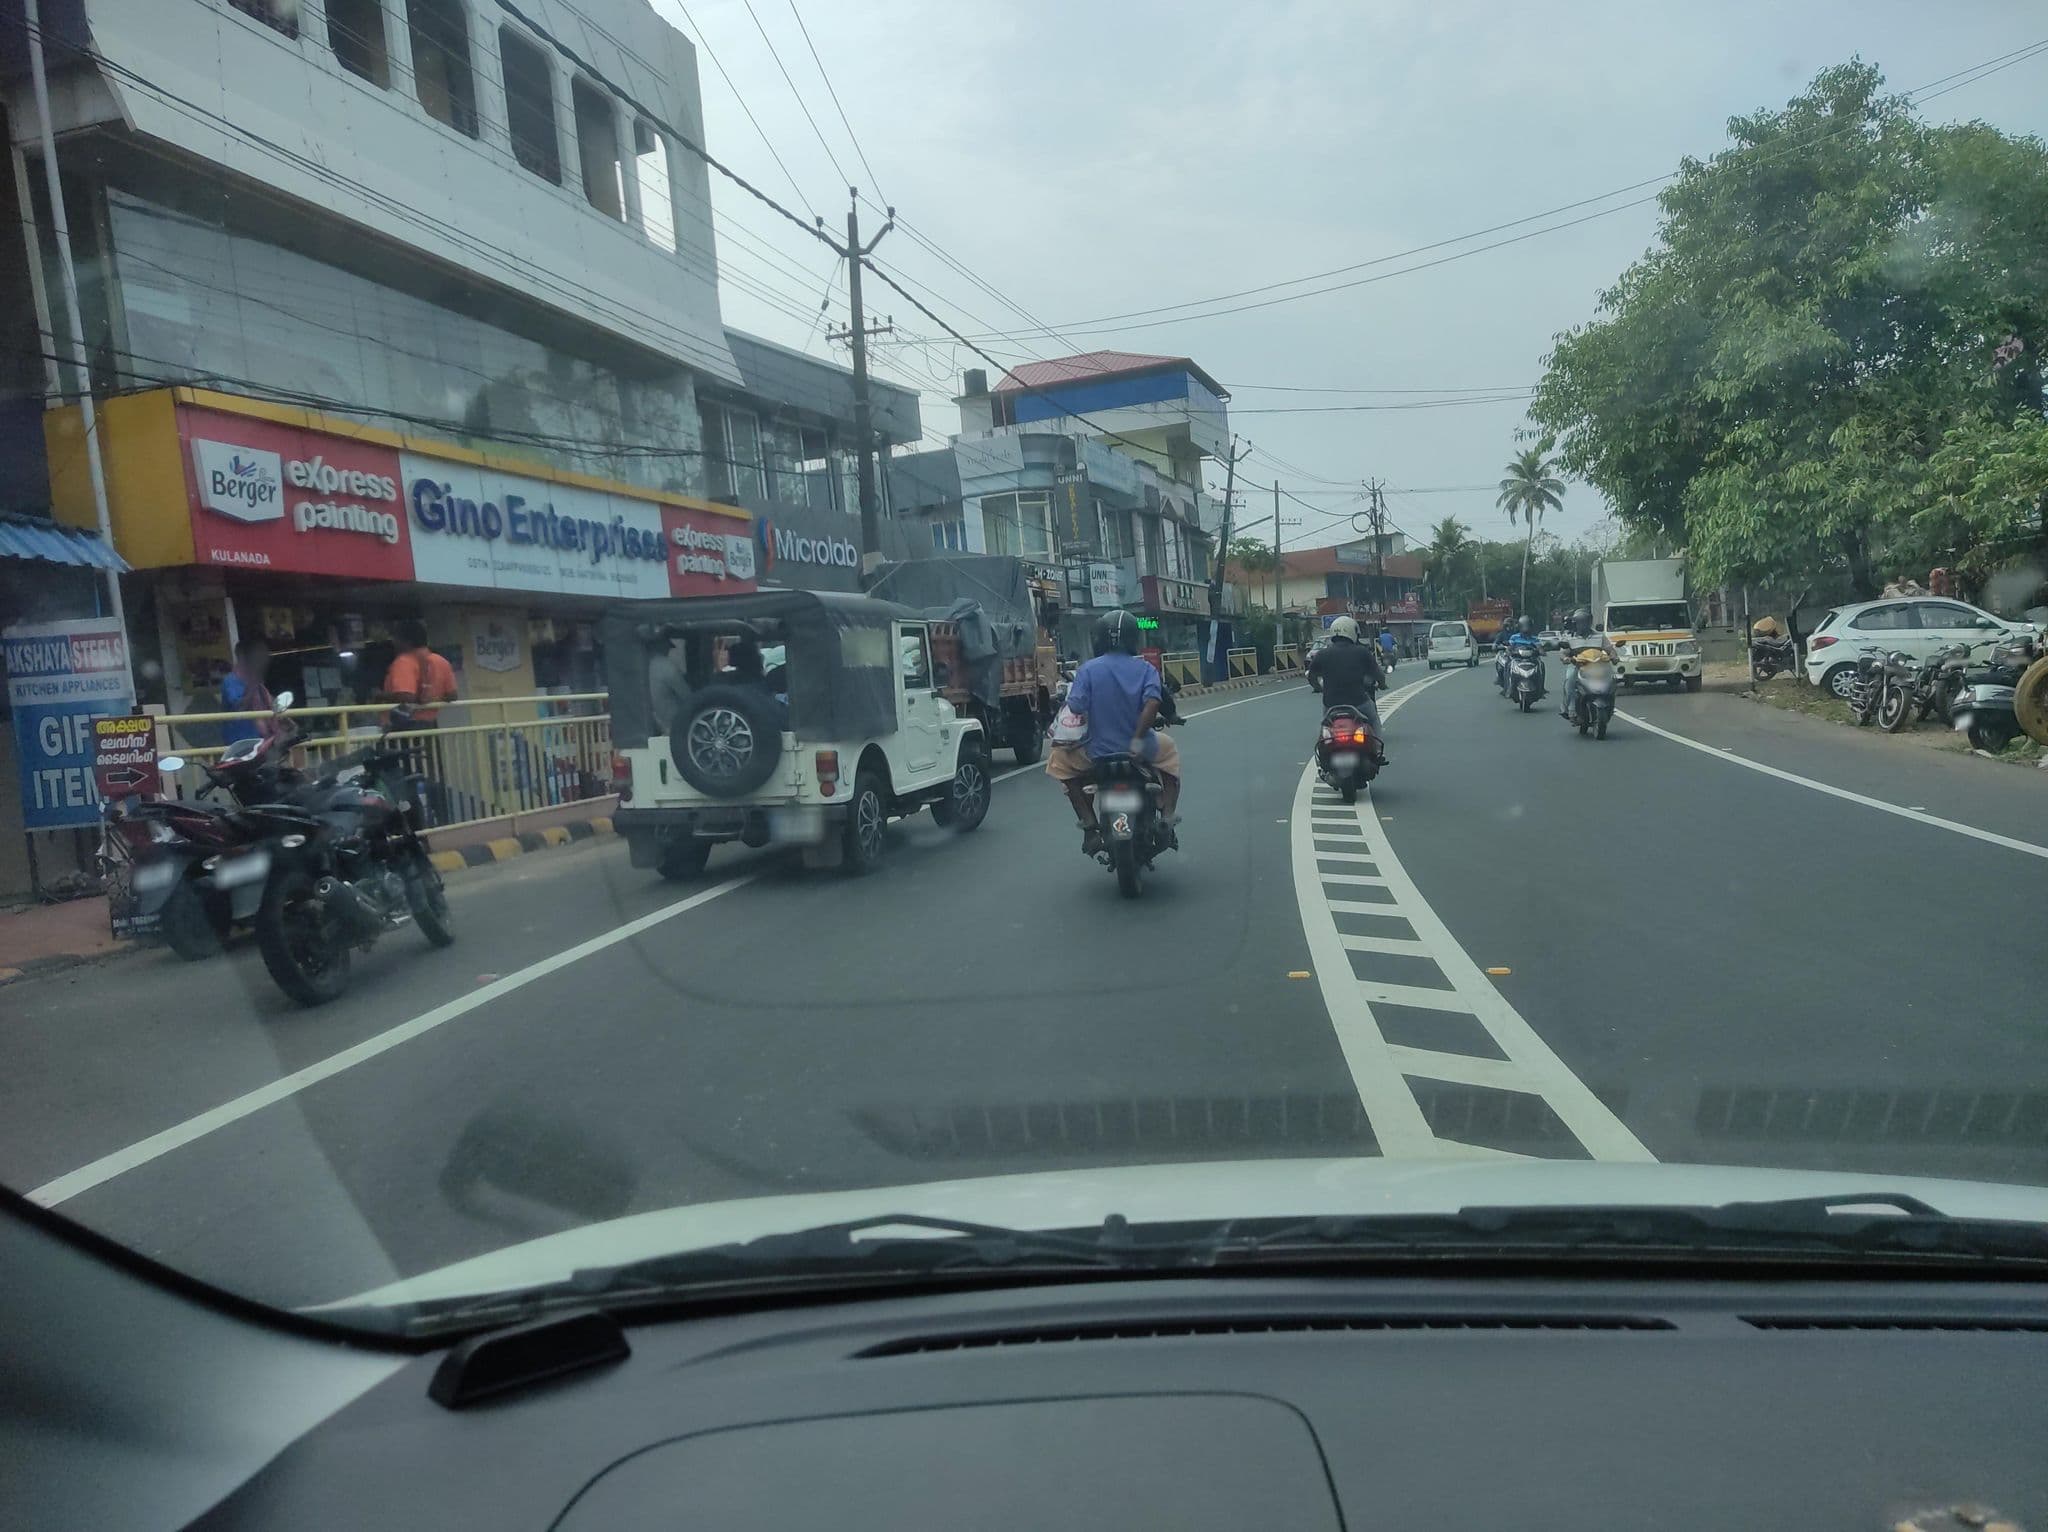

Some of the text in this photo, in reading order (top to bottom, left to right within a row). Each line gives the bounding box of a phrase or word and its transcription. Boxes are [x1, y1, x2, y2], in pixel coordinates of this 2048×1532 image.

[212, 470, 276, 508] Berger
[287, 456, 397, 502] express
[294, 501, 399, 544] painting
[410, 478, 669, 565] Gino Enterprises
[672, 523, 724, 552] express
[211, 549, 271, 565] KULANADA
[775, 528, 858, 567] Microlab
[678, 553, 726, 580] painting
[6, 639, 125, 673] AKSHAYA STEELS
[16, 678, 120, 697] KITCHEN APPLIANCES
[39, 713, 109, 757] GIF
[96, 720, 152, 734] അക്ഷയ
